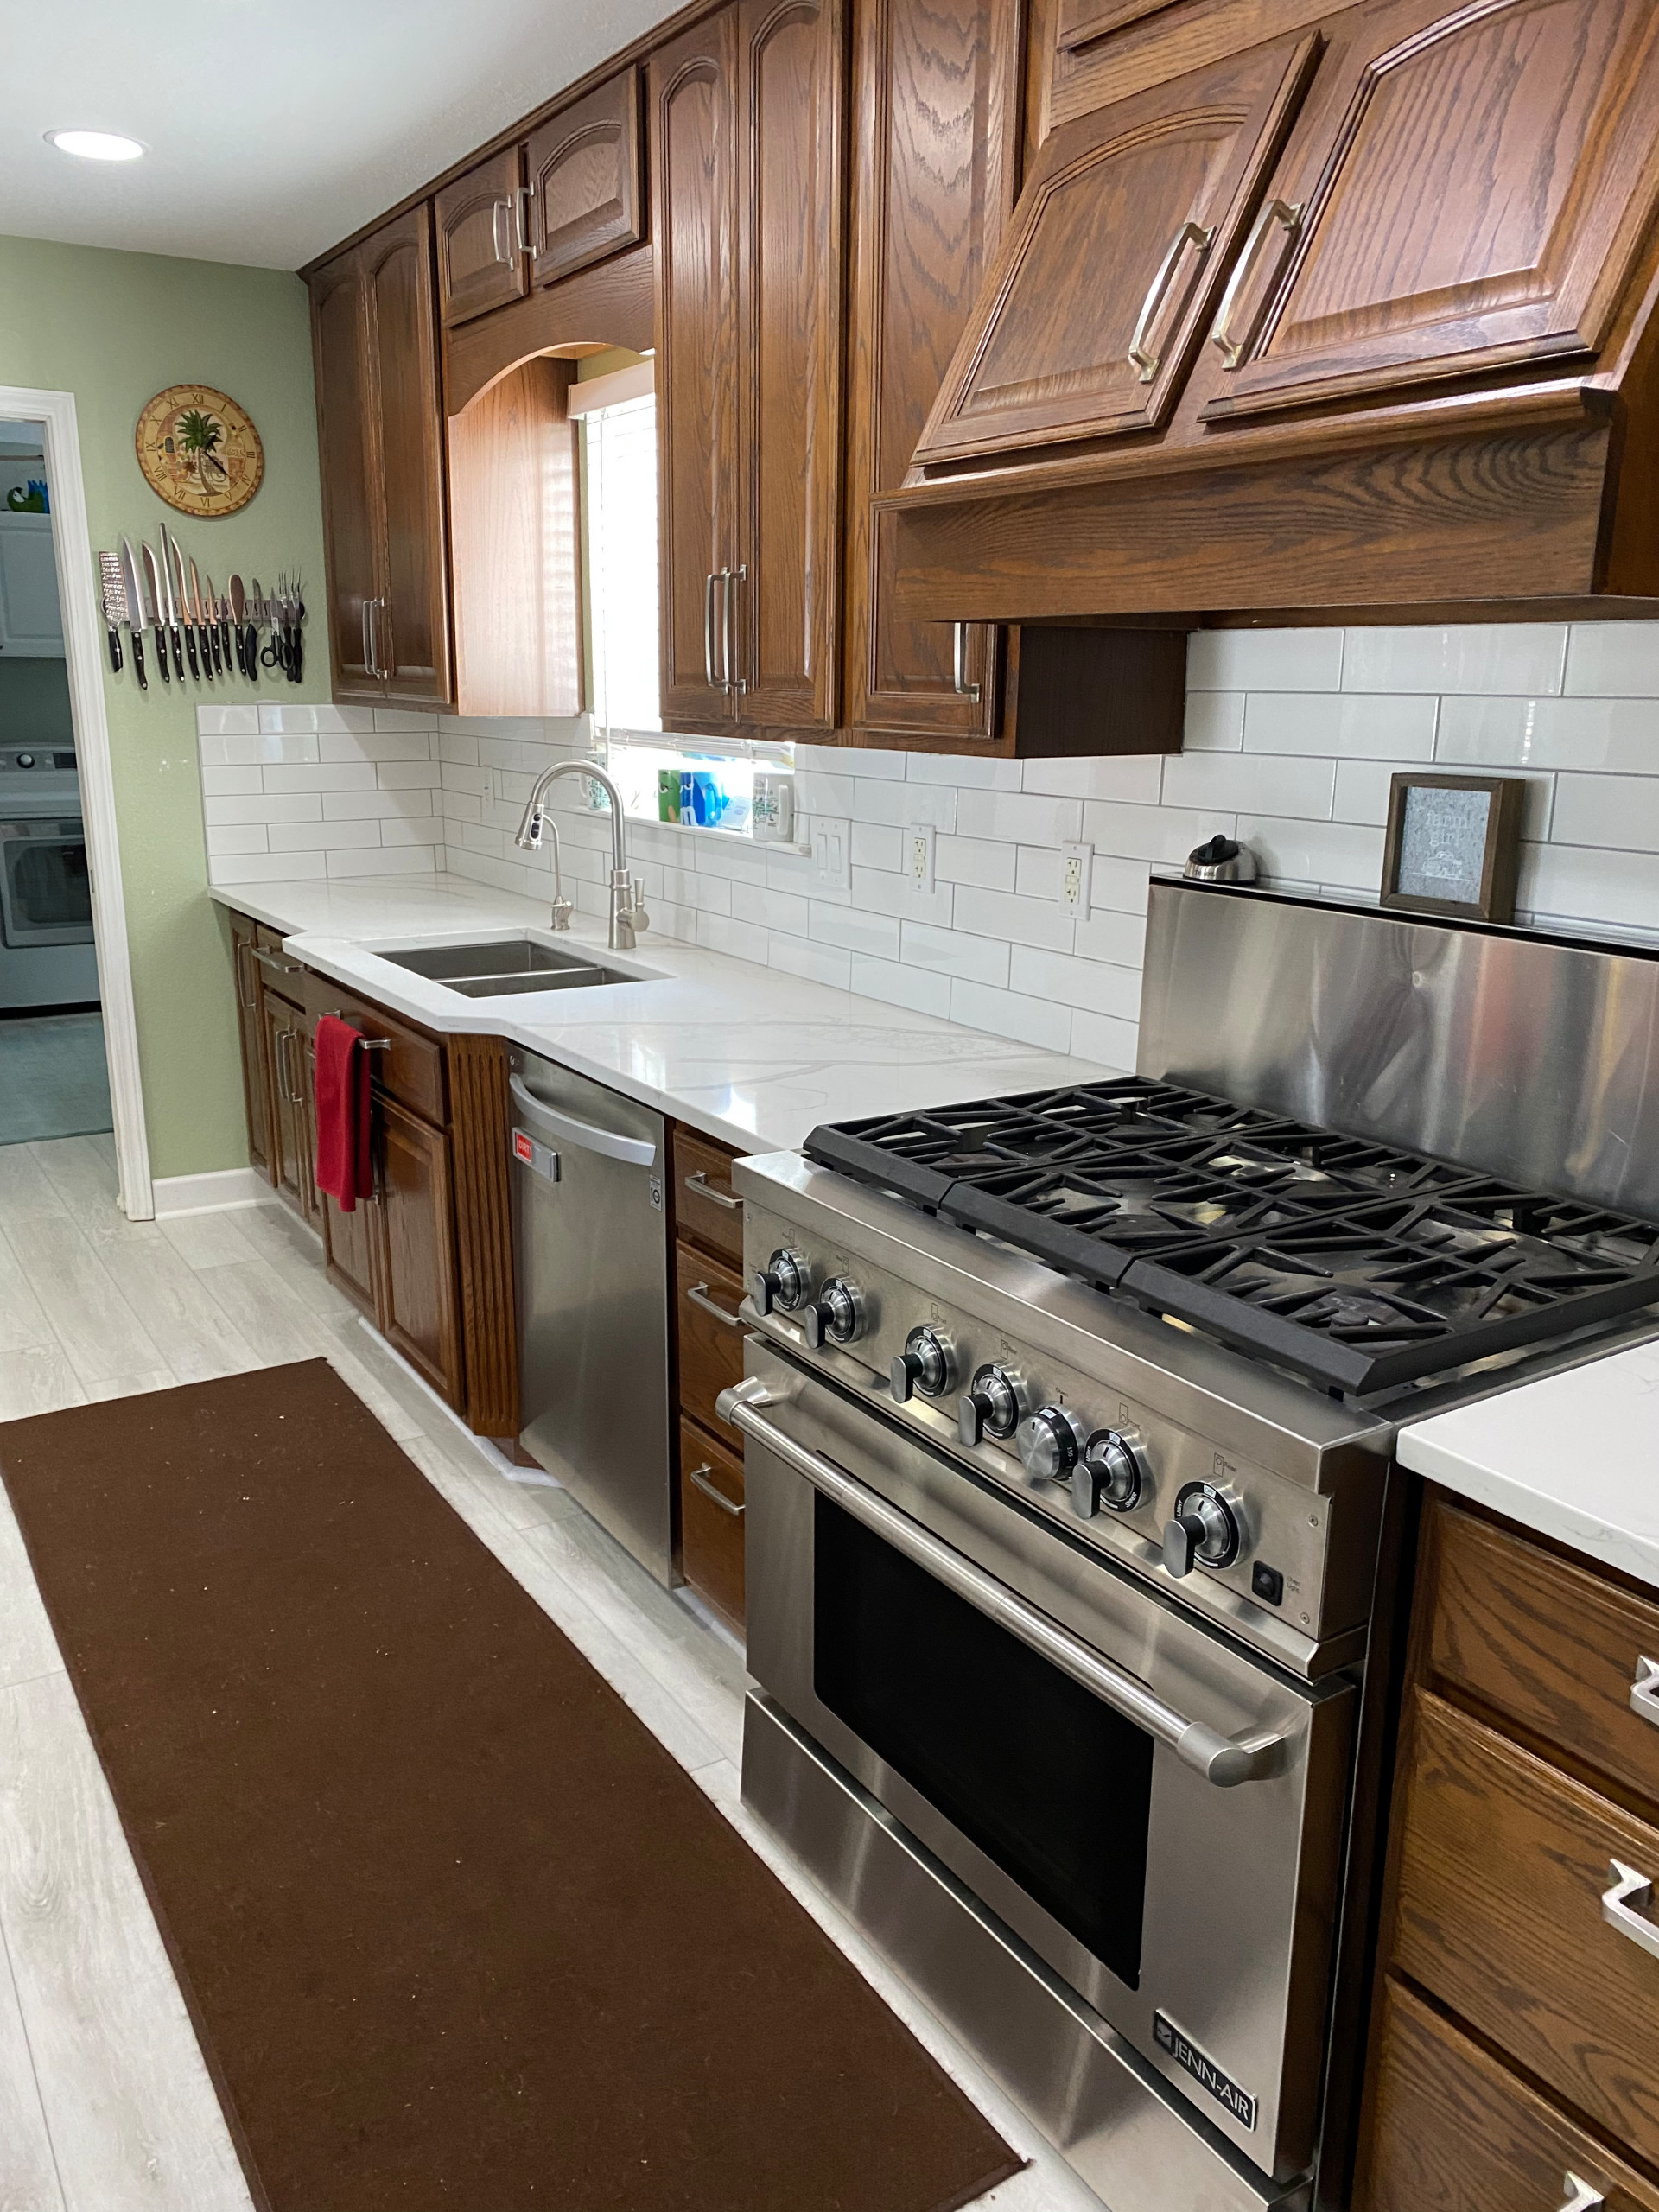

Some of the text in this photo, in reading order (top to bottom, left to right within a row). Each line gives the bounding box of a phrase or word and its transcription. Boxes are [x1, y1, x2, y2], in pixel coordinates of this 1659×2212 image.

[166, 398, 179, 410] XI
[192, 393, 205, 404] XII
[220, 404, 226, 412] I
[151, 416, 162, 426] X
[238, 424, 248, 433] II
[145, 442, 156, 452] IX
[153, 467, 168, 481] VIII
[174, 486, 187, 501] VII
[224, 492, 232, 501] V
[200, 497, 211, 508] VI
[1425, 810, 1468, 829] farm
[1429, 829, 1459, 847] girl
[1055, 1387, 1070, 1397] Oven
[1173, 2037, 1249, 2120] JENN-AIR
